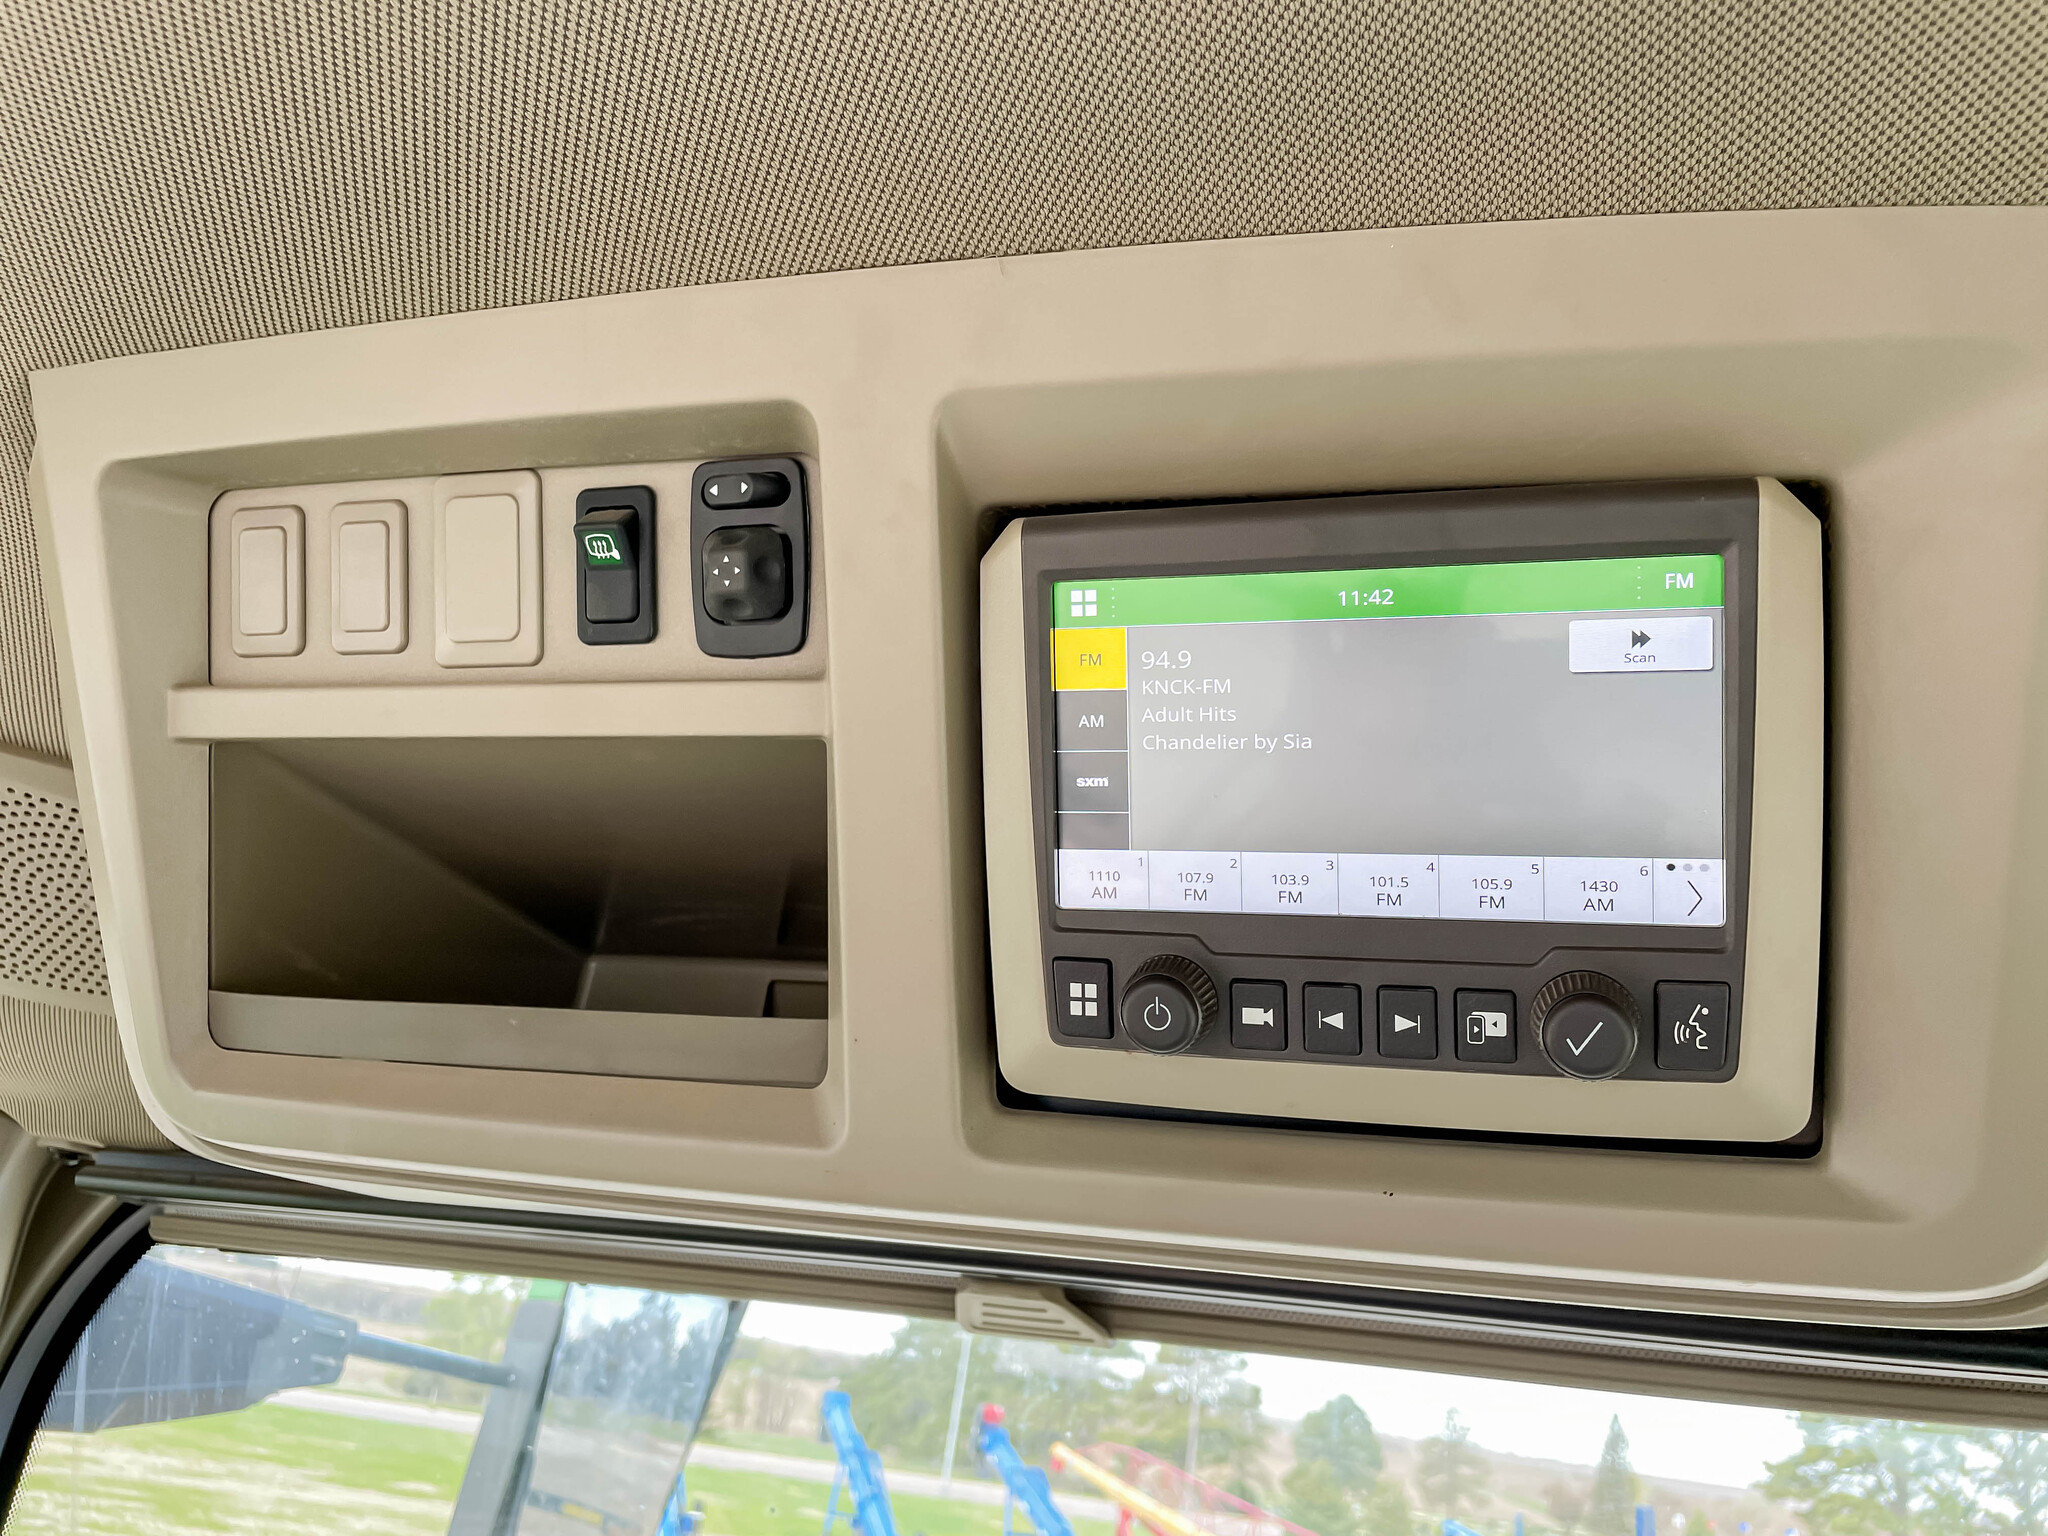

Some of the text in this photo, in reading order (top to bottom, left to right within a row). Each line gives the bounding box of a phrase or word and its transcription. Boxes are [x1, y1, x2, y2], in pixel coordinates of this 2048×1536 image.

[1666, 573, 1693, 589] FM
[1338, 589, 1394, 606] 11:42
[1079, 653, 1102, 667] FM
[1142, 651, 1191, 669] 94.9
[1624, 652, 1656, 664] Scan
[1143, 679, 1230, 694] KNCK-FM
[1078, 714, 1104, 728] AM
[1142, 706, 1237, 722] Adult Hits
[1143, 734, 1311, 753] Chandelier by Sia
[1076, 776, 1109, 789] sxm
[1229, 858, 1238, 869] 2
[1325, 860, 1334, 871] 3
[1426, 862, 1436, 873] 4
[1531, 863, 1540, 875] 5
[1089, 870, 1121, 882] 1110
[1177, 872, 1214, 884] 107.9
[1639, 865, 1649, 877] 6
[1271, 874, 1310, 886] 103.9
[1369, 876, 1409, 888] 101.5
[1471, 878, 1513, 891] 105.9
[1580, 880, 1619, 893] 1430
[1091, 886, 1118, 900] AM
[1184, 888, 1208, 902] FM
[1278, 890, 1303, 904] FM
[1376, 892, 1402, 907] FM
[1479, 895, 1505, 910] FM
[1583, 897, 1614, 912] AM
